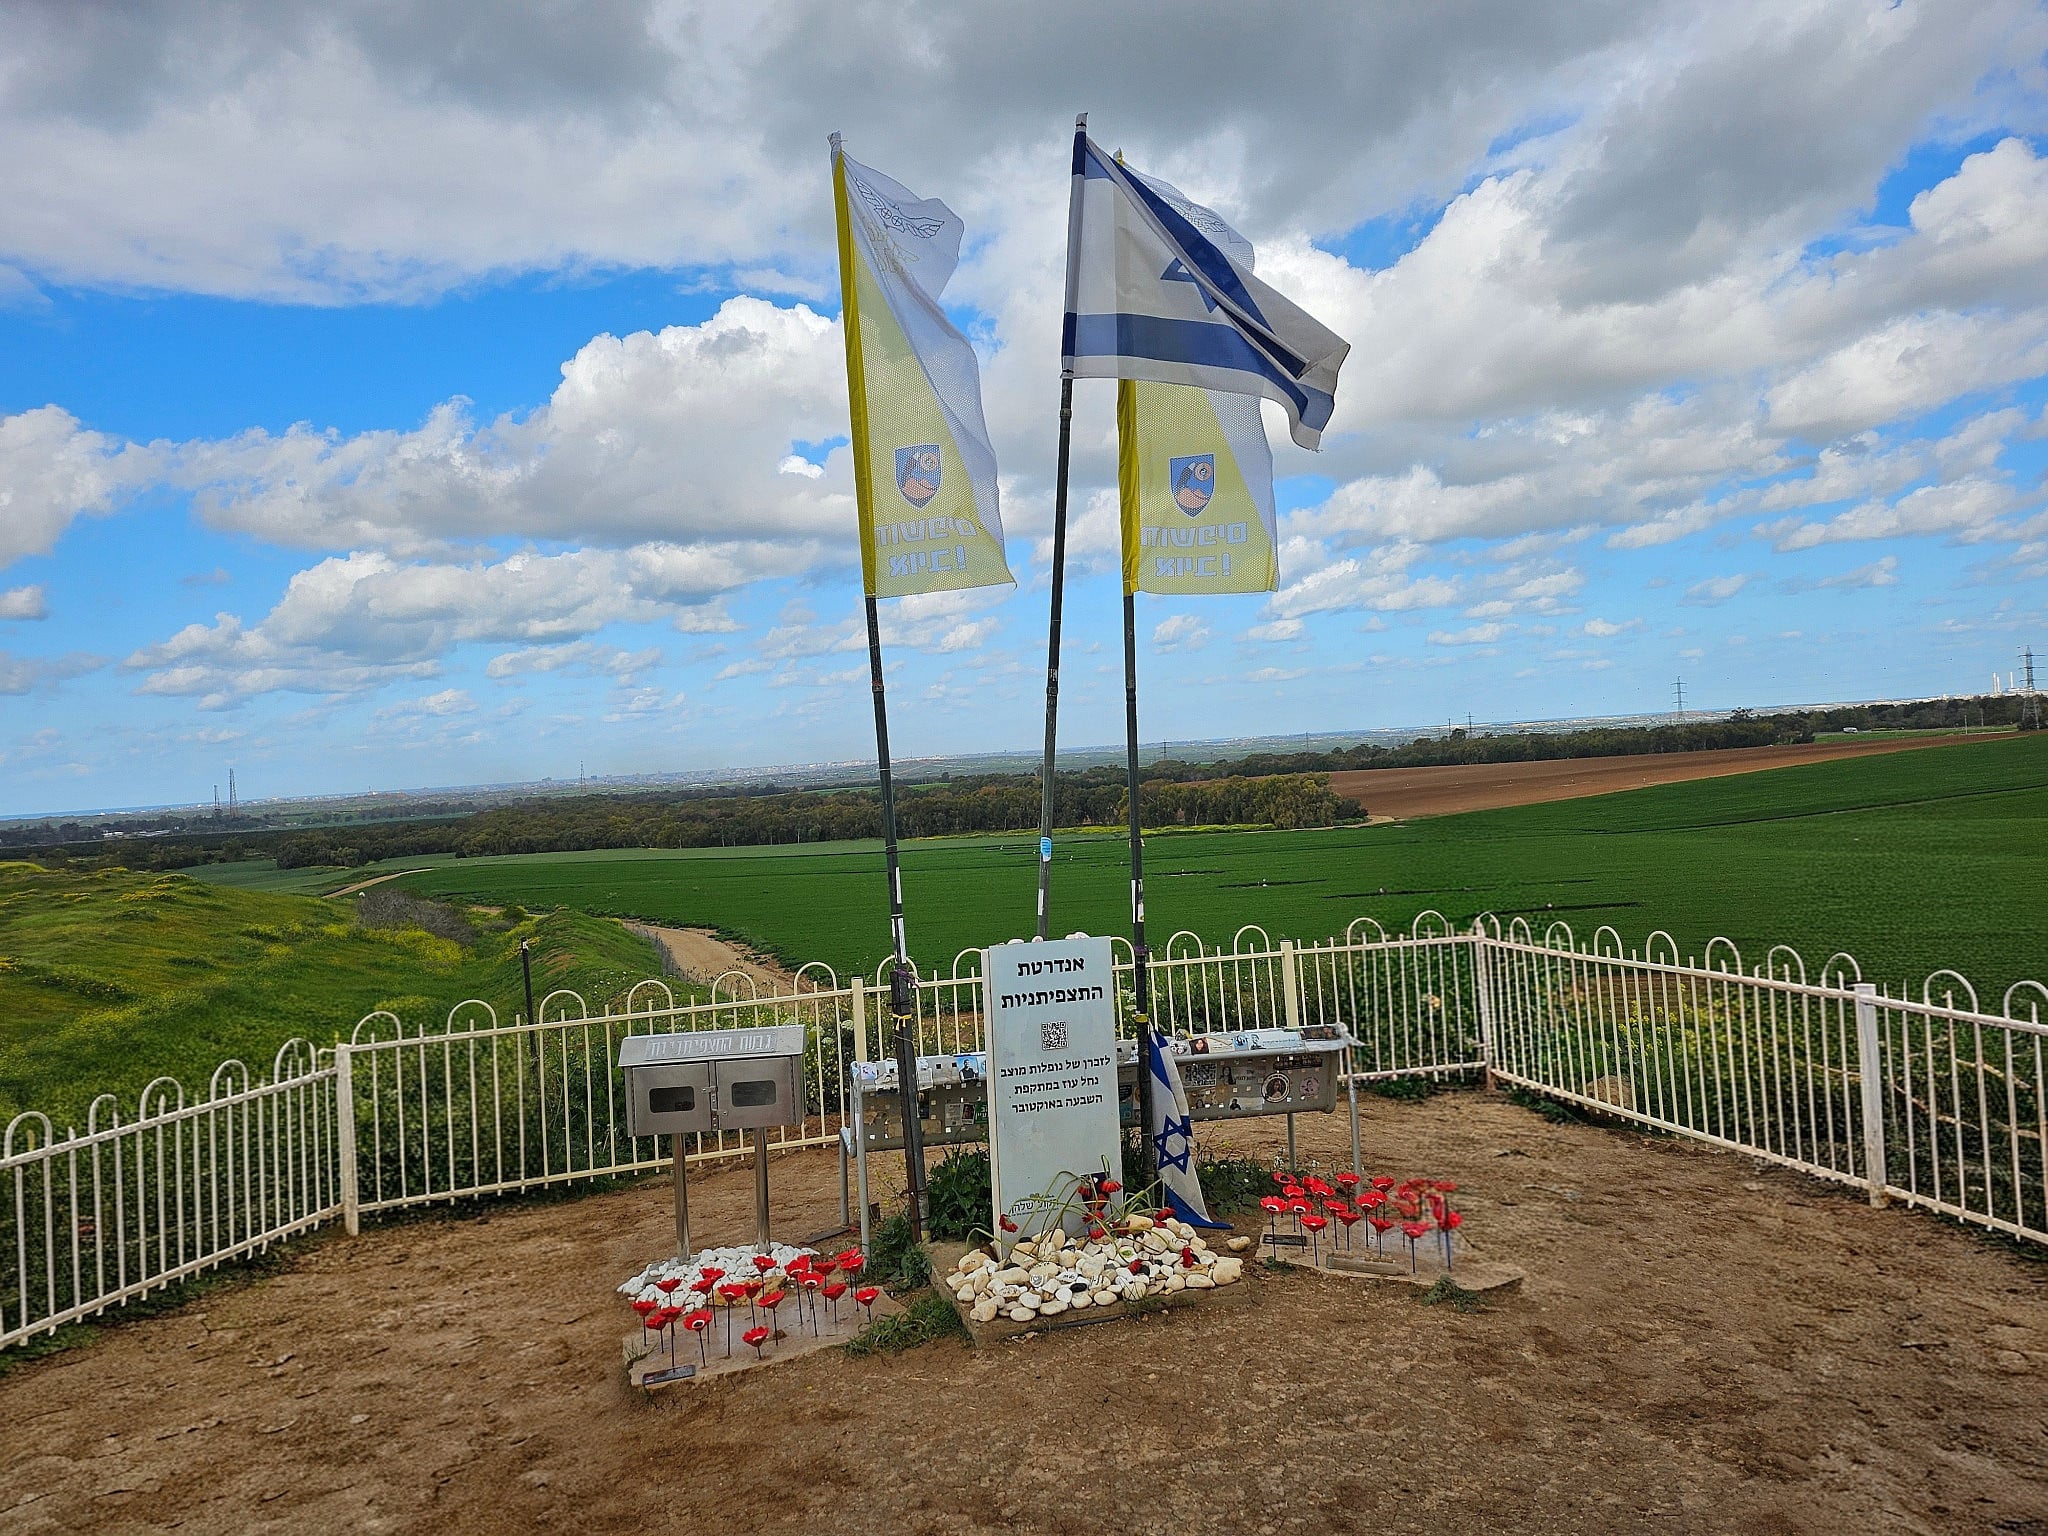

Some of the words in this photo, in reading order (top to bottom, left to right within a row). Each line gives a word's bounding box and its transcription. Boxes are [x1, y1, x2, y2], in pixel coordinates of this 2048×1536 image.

[1017, 957, 1085, 977] אנדרטת
[1001, 986, 1103, 1009] התצפיתניות
[1029, 1062, 1064, 1074] נופלות
[1066, 1059, 1081, 1070] של
[1083, 1055, 1111, 1069] לזכרן
[1000, 1065, 1027, 1078] מוצב
[1014, 1081, 1060, 1095] במתקפת
[1063, 1079, 1079, 1090] עוז
[1081, 1076, 1099, 1087] נחל
[1012, 1099, 1063, 1113] באוקטובר
[1065, 1094, 1103, 1108] השבעה
